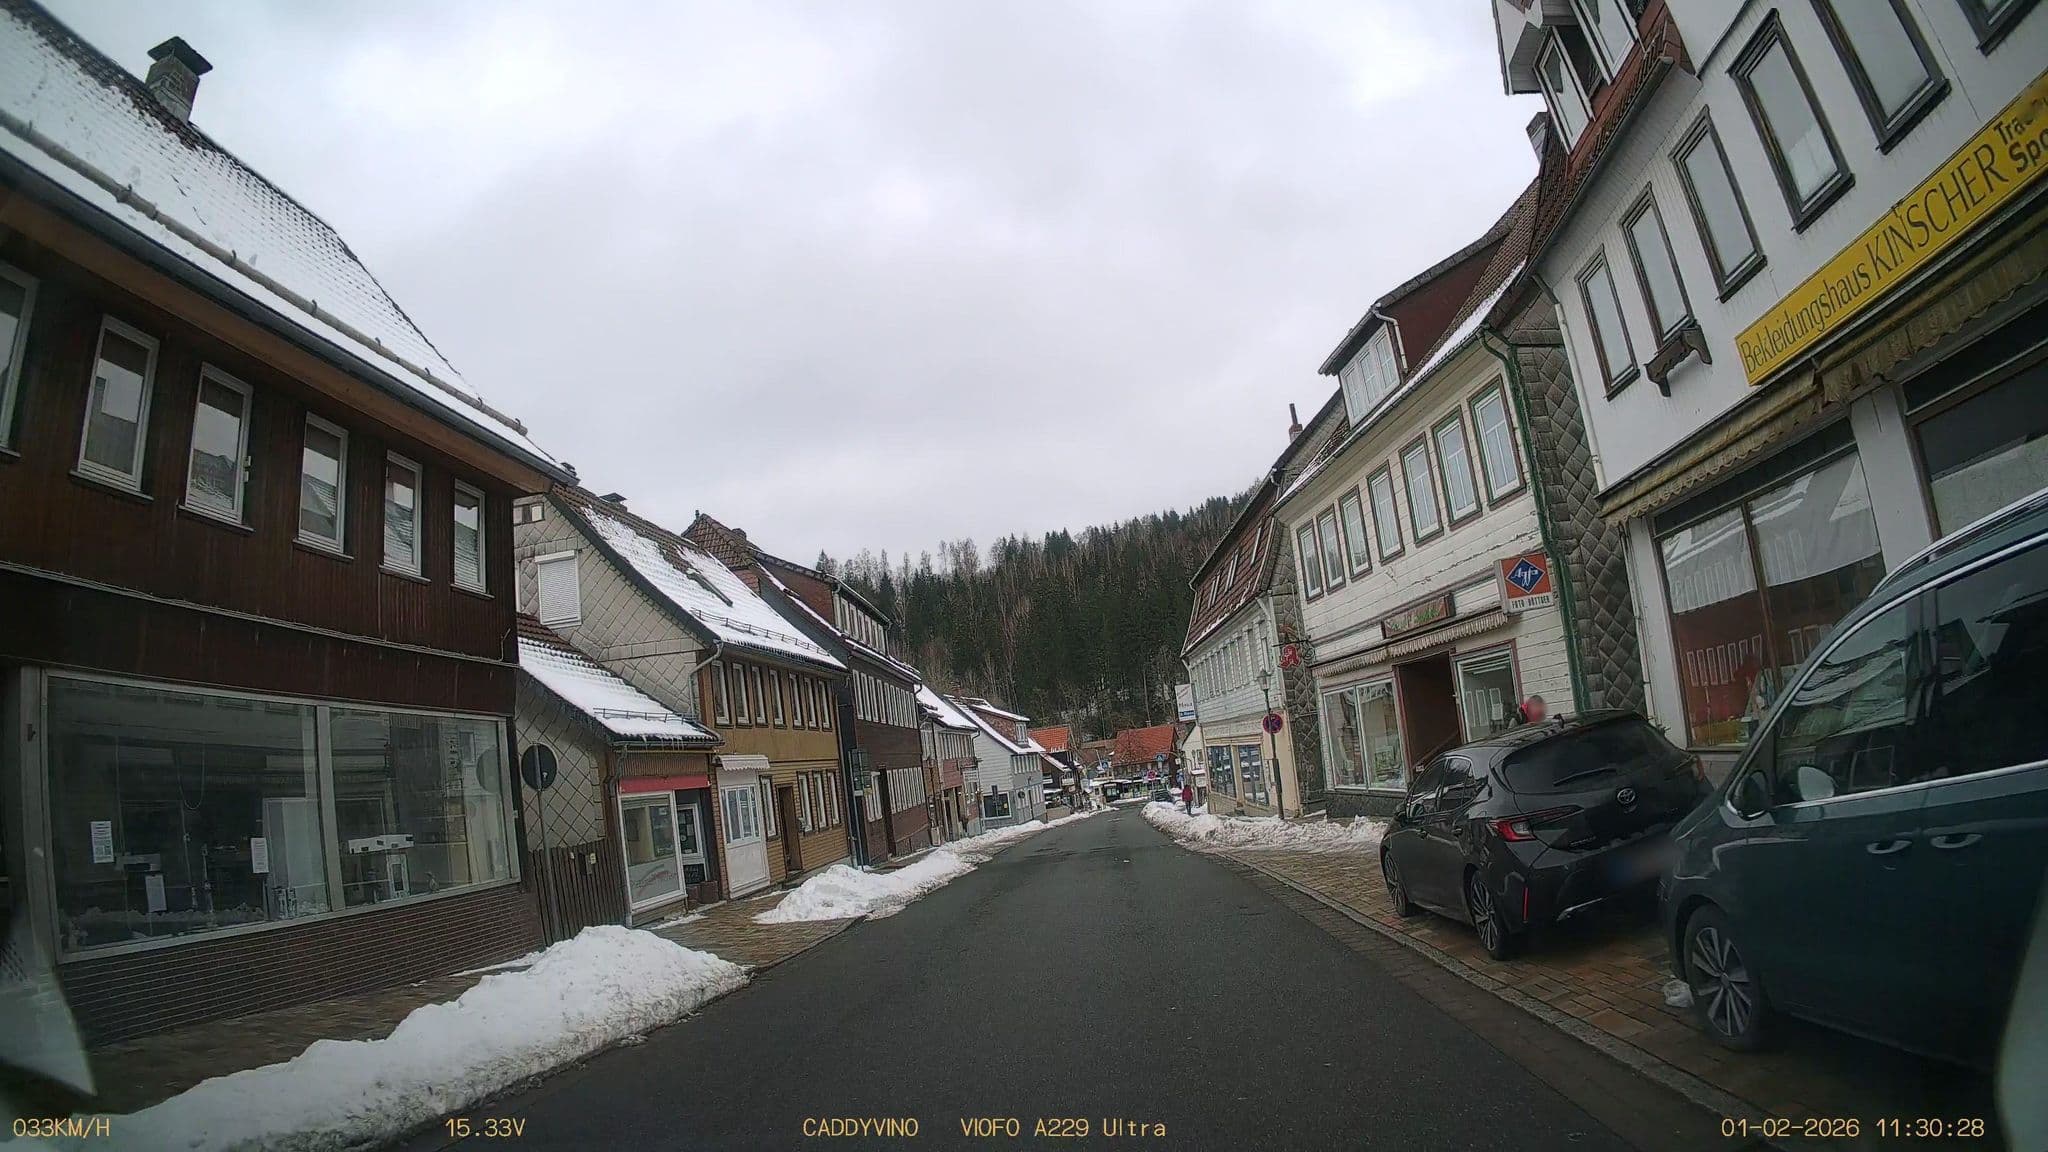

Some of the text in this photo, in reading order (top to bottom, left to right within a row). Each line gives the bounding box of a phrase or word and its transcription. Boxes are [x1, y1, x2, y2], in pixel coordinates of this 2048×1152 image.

[1740, 143, 2010, 374] Bekleidungshaus KINSCHER
[1511, 566, 1539, 587] Agfa
